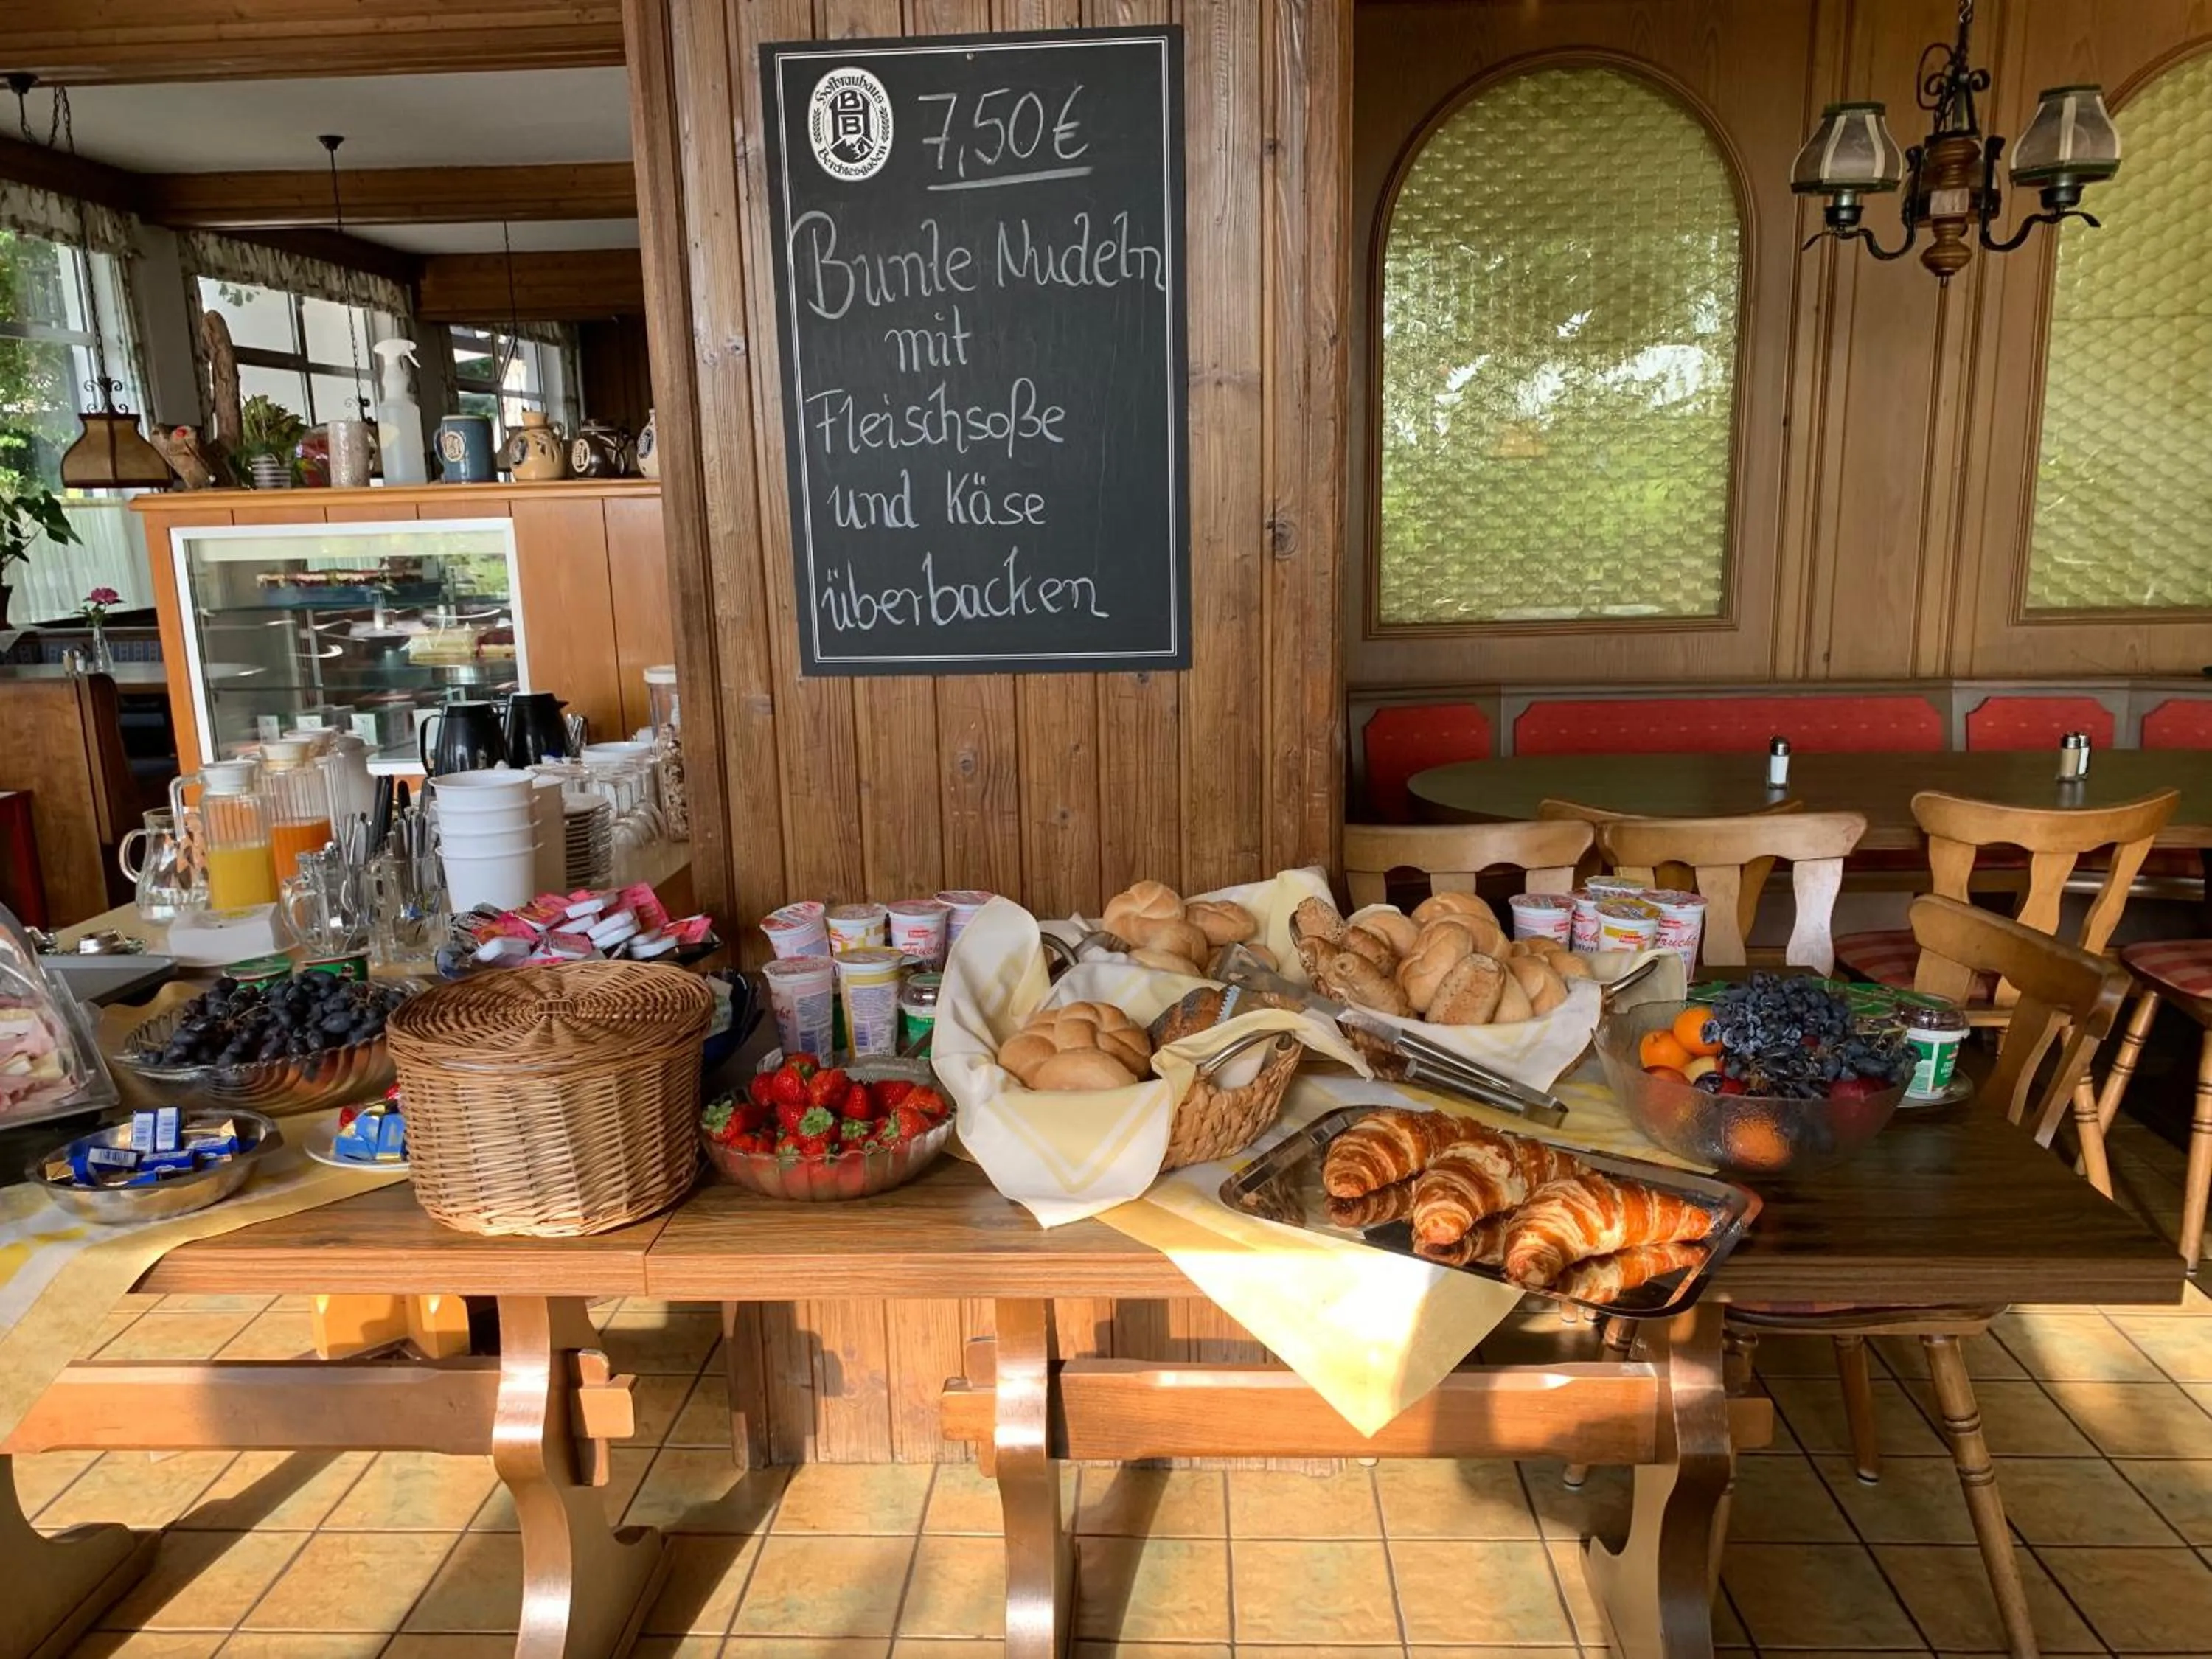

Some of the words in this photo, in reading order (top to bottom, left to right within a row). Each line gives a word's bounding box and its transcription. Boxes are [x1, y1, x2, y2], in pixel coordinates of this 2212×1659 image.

[997, 210, 1166, 291] Nudeln
[883, 305, 972, 373] mit
[805, 377, 1066, 459] Fleischsoße
[827, 468, 920, 530] und
[947, 470, 1046, 526] Käse
[821, 546, 1110, 633] überbacken
